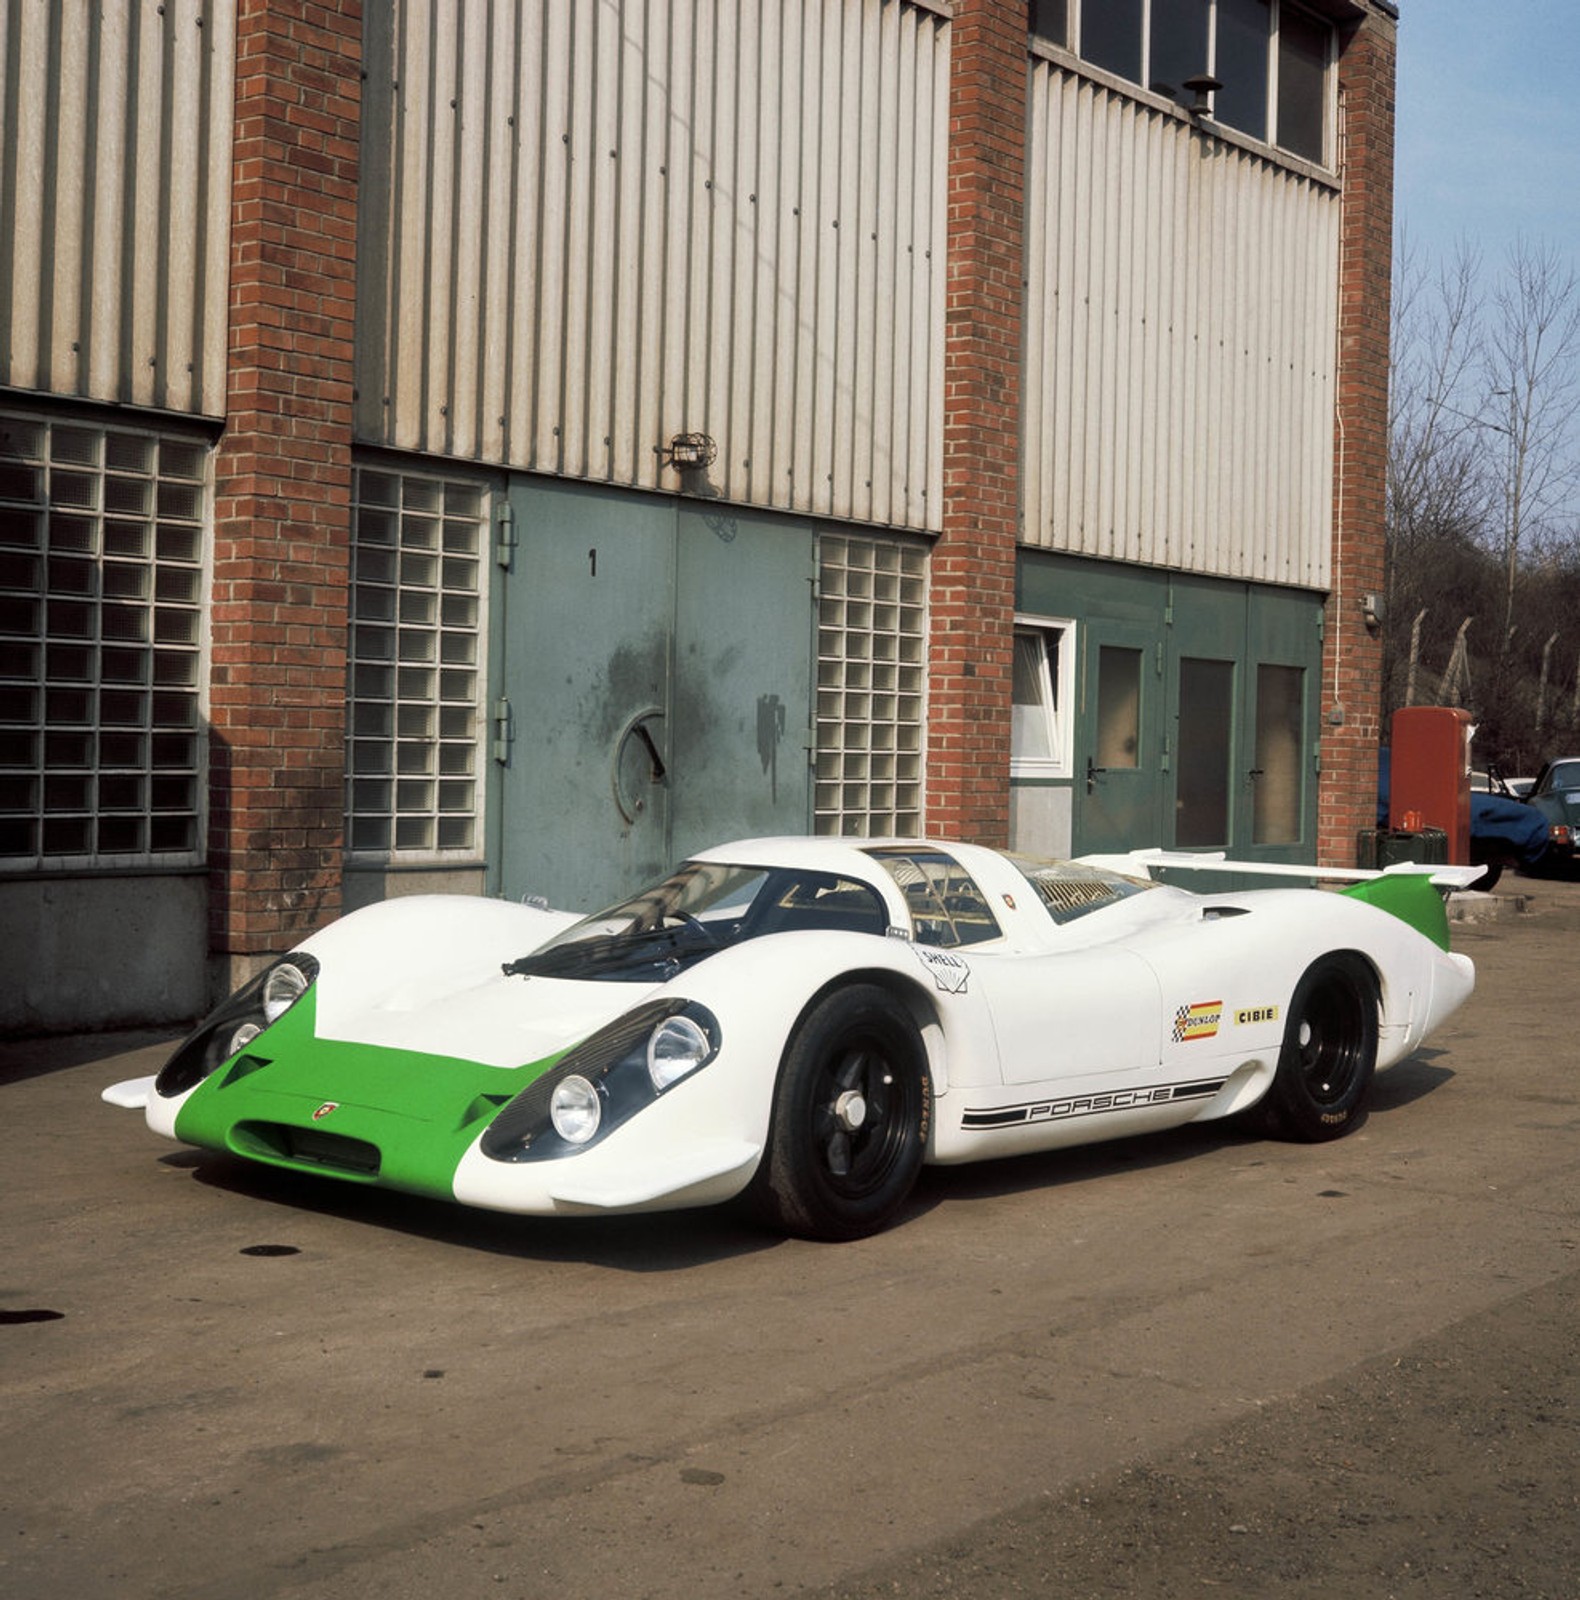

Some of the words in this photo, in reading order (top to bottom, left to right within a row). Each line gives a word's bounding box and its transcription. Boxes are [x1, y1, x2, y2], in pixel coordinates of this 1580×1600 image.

[589, 549, 597, 577] 1
[922, 951, 962, 968] SHELL
[1186, 1014, 1221, 1027] DUNLOP
[1238, 1008, 1274, 1023] CIBIE
[1029, 1088, 1172, 1120] PORSCHE
